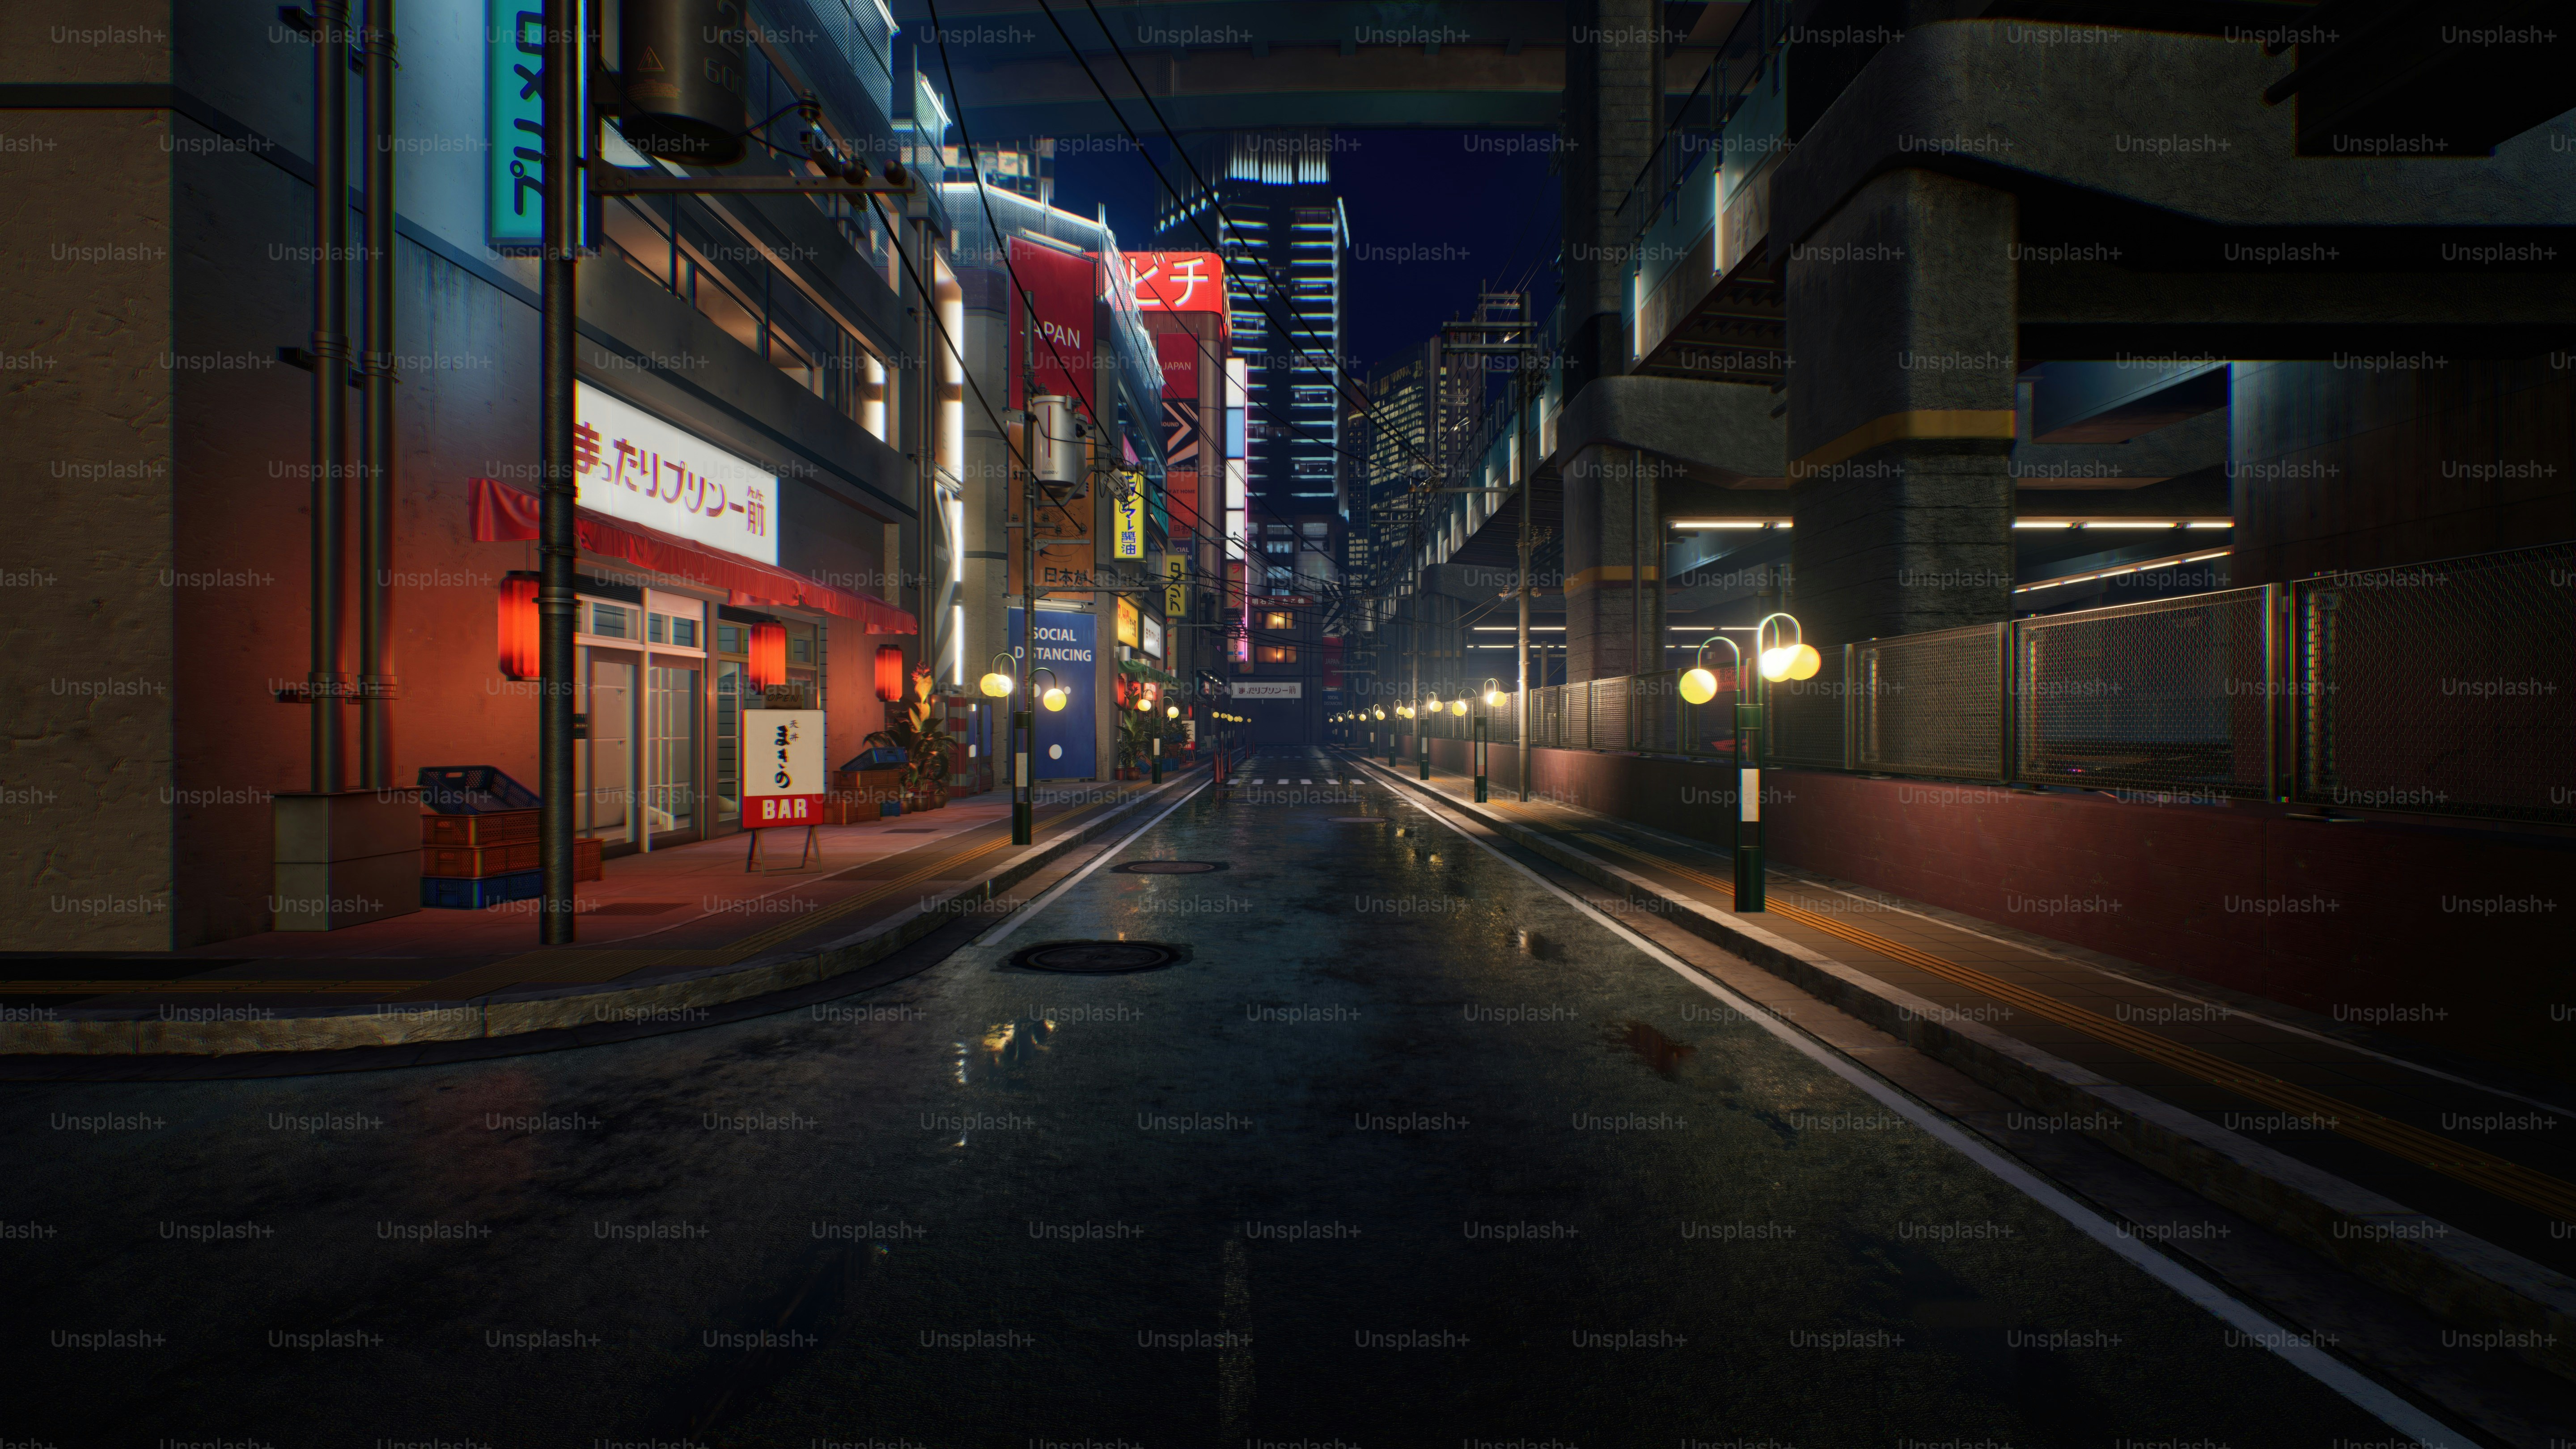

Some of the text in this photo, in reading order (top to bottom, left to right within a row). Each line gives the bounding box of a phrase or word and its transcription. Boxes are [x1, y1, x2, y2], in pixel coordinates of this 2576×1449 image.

[1101, 252, 1209, 307] ビチ
[1020, 322, 1080, 349] APAN
[1163, 361, 1191, 371] JAPAN
[1033, 628, 1076, 642] SOCIAL
[1015, 646, 1092, 661] DSTANCING
[766, 693, 799, 702] OPEN
[1238, 686, 1296, 695] まったりプリン一筋
[763, 798, 808, 820] BAR
